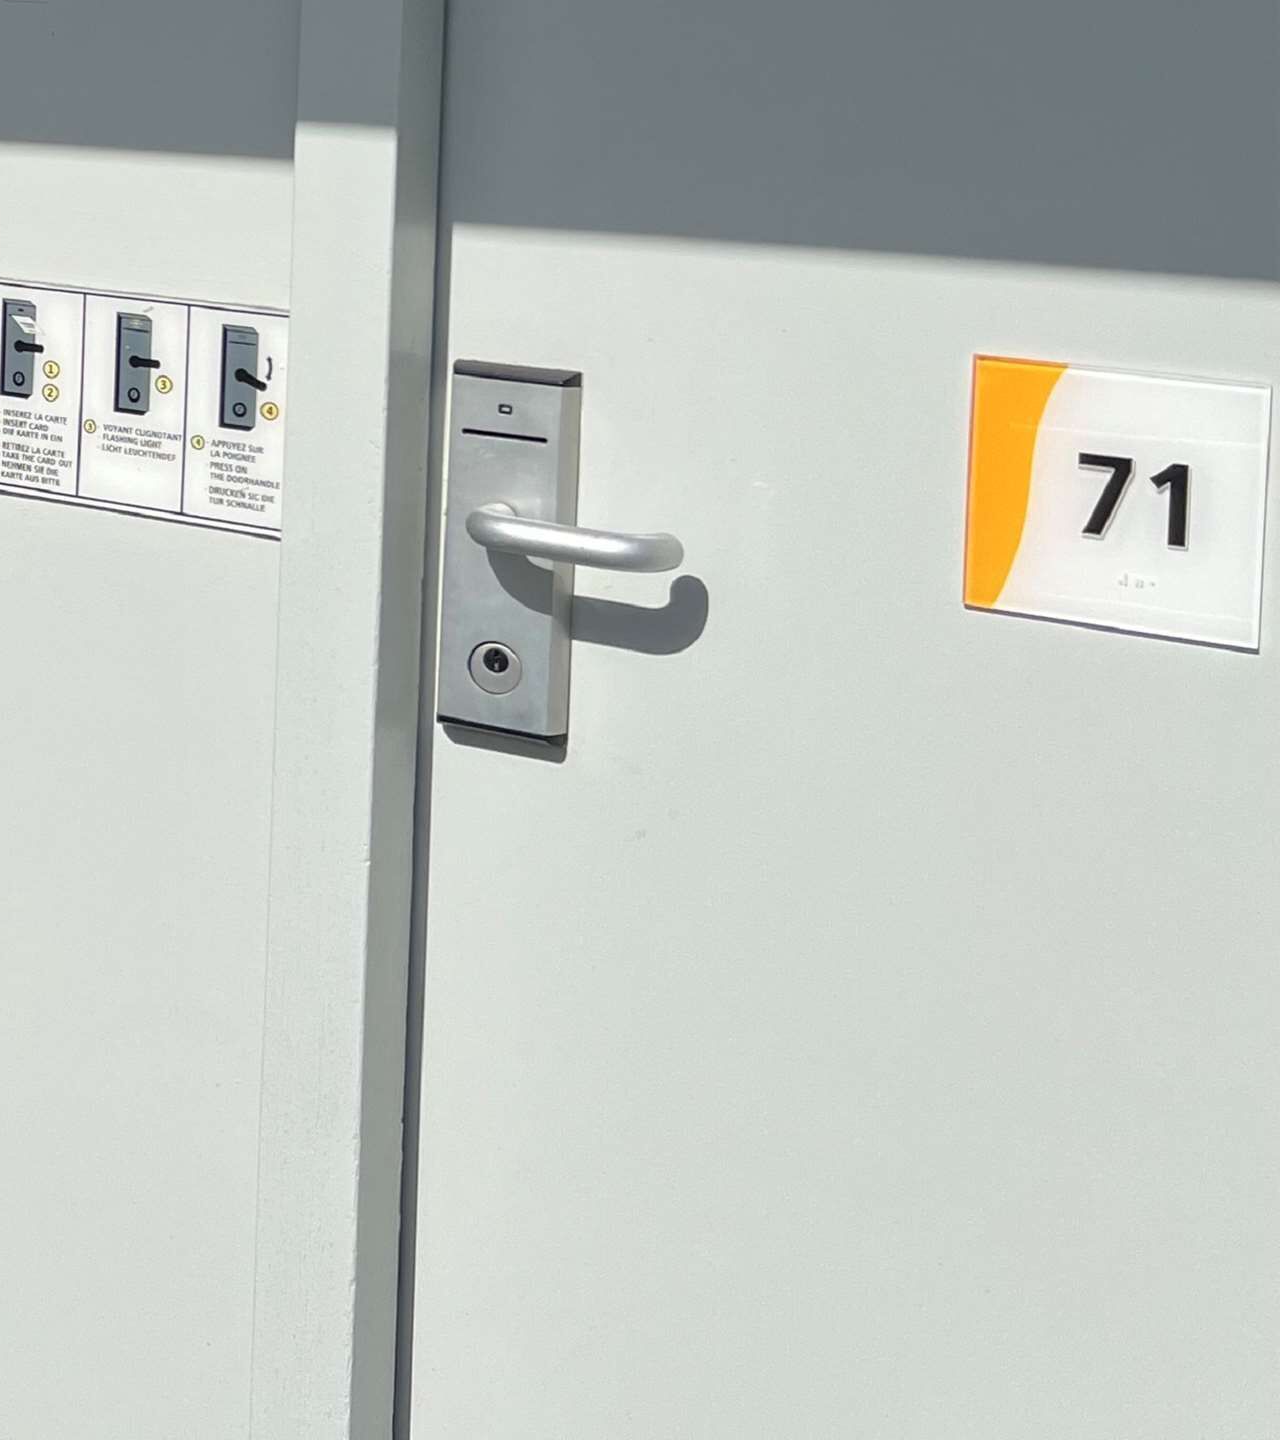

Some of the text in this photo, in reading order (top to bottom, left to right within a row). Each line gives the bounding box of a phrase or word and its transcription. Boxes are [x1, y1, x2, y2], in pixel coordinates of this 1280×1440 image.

[3, 409, 32, 419] INSEREZ
[45, 415, 67, 425] CARTE
[3, 419, 49, 431] INSERT CARD
[17, 430, 39, 439] KARTE
[103, 424, 133, 434] VOYANT
[135, 429, 182, 441] CLIGNOTANT
[103, 434, 138, 445] FLASHING
[2, 442, 30, 452] RETIREZ
[43, 448, 64, 458] CARTE
[102, 444, 122, 454] LICHT
[2, 451, 19, 459] TAKE
[22, 454, 35, 462] THE
[37, 456, 55, 465] CARD
[210, 462, 247, 474] PRESS ON
[1, 471, 23, 480] KARTE
[210, 472, 280, 489] THE DOORHANDLE
[1078, 452, 1190, 550] 71
